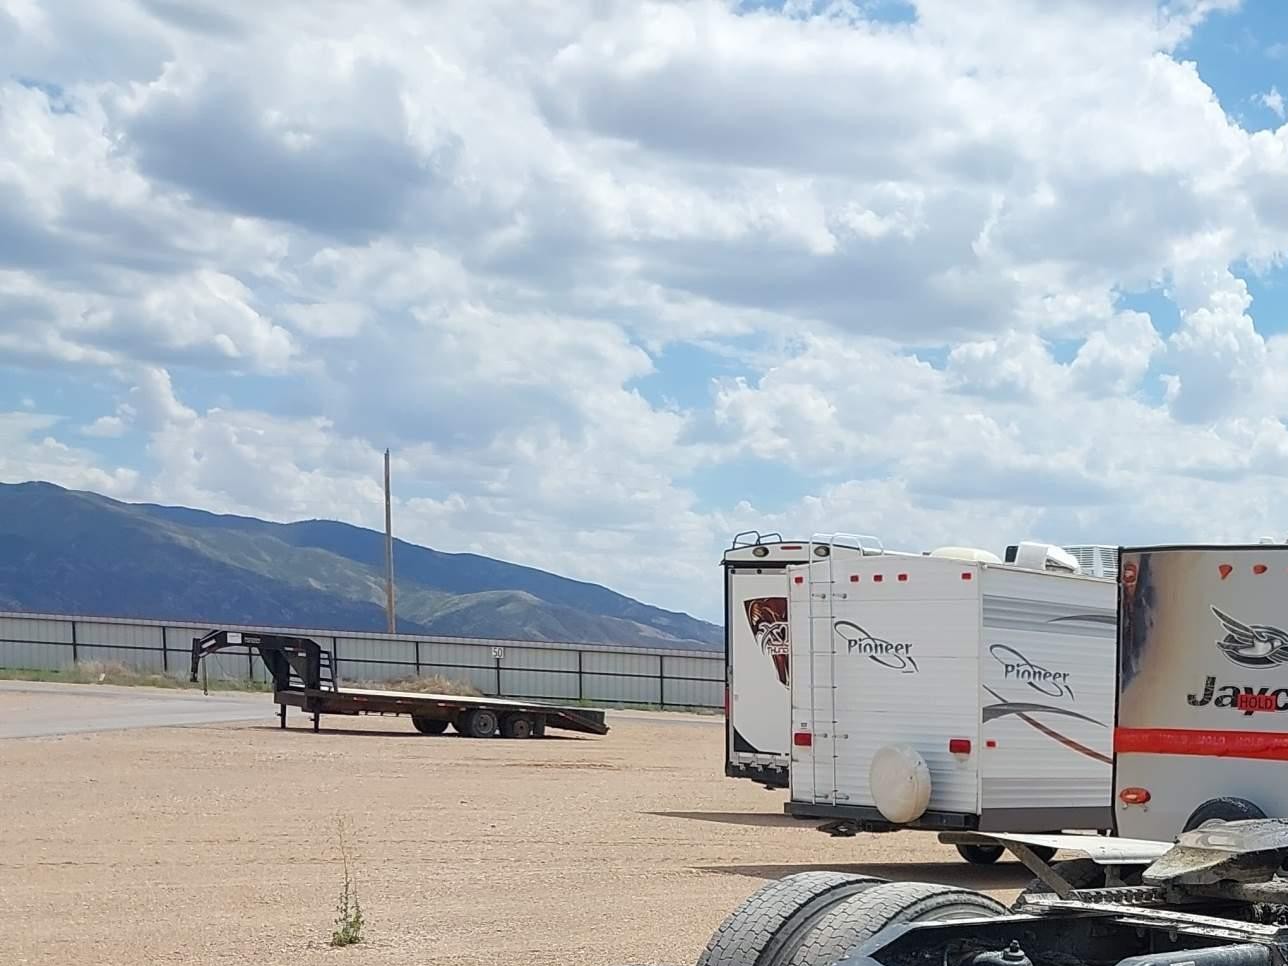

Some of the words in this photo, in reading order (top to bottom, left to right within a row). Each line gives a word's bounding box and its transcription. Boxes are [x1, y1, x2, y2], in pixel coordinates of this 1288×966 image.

[847, 638, 913, 655] Pioneer
[1004, 663, 1070, 684] Pioneer
[1239, 695, 1275, 710] HOLD
